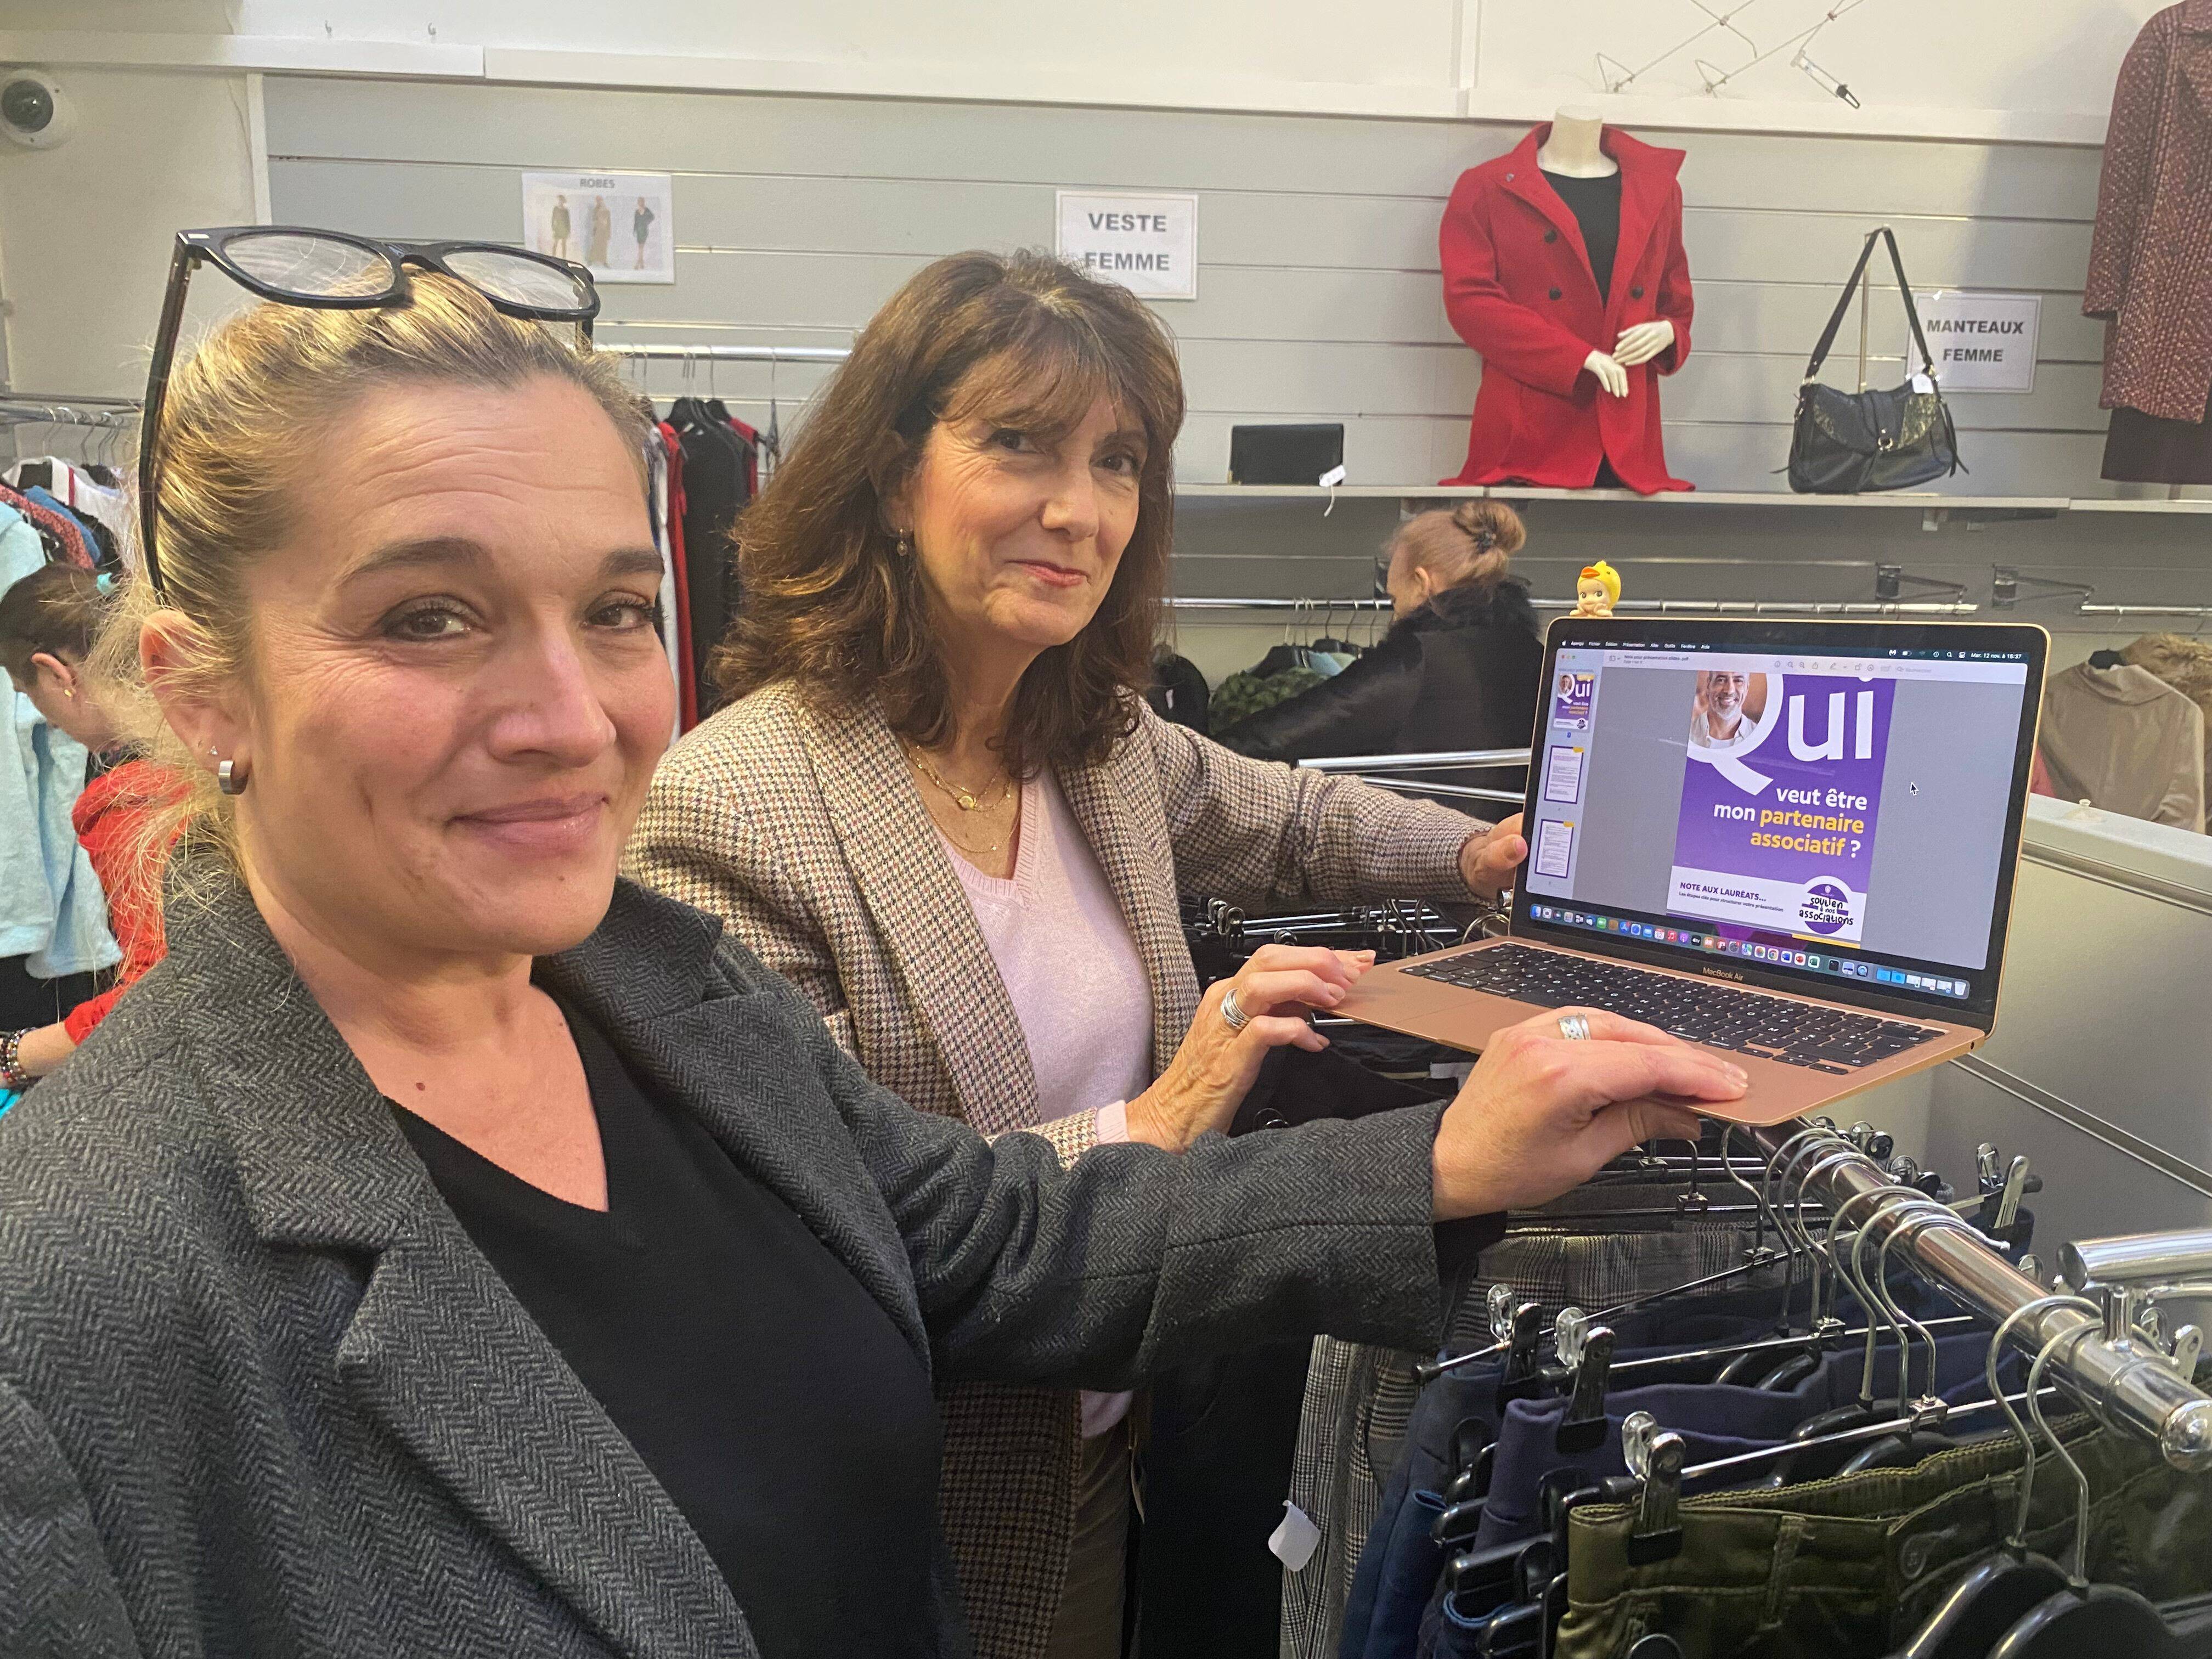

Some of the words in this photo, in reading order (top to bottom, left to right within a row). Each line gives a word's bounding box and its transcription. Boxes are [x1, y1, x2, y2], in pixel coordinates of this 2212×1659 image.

[579, 178, 616, 189] ROBES
[1088, 213, 1167, 233] VESTE
[1085, 252, 1170, 271] FEMME
[1927, 319, 2024, 334] MANTEAUX
[1943, 348, 2004, 362] FEMME
[1686, 674, 1874, 796] Qui
[1776, 788, 1821, 806] veut
[1825, 788, 1868, 810] être
[1713, 804, 1756, 821] mon
[1759, 809, 1864, 834] partenaire
[1750, 832, 1846, 856] associatif
[1850, 840, 1861, 858] ?
[1680, 882, 1701, 891] NOTE
[1702, 885, 1719, 894] AUX
[1720, 888, 1767, 902] LAURÉATS...
[1810, 897, 1843, 909] soutien
[1799, 910, 1854, 926] associations
[1702, 967, 1733, 979] MacBook
